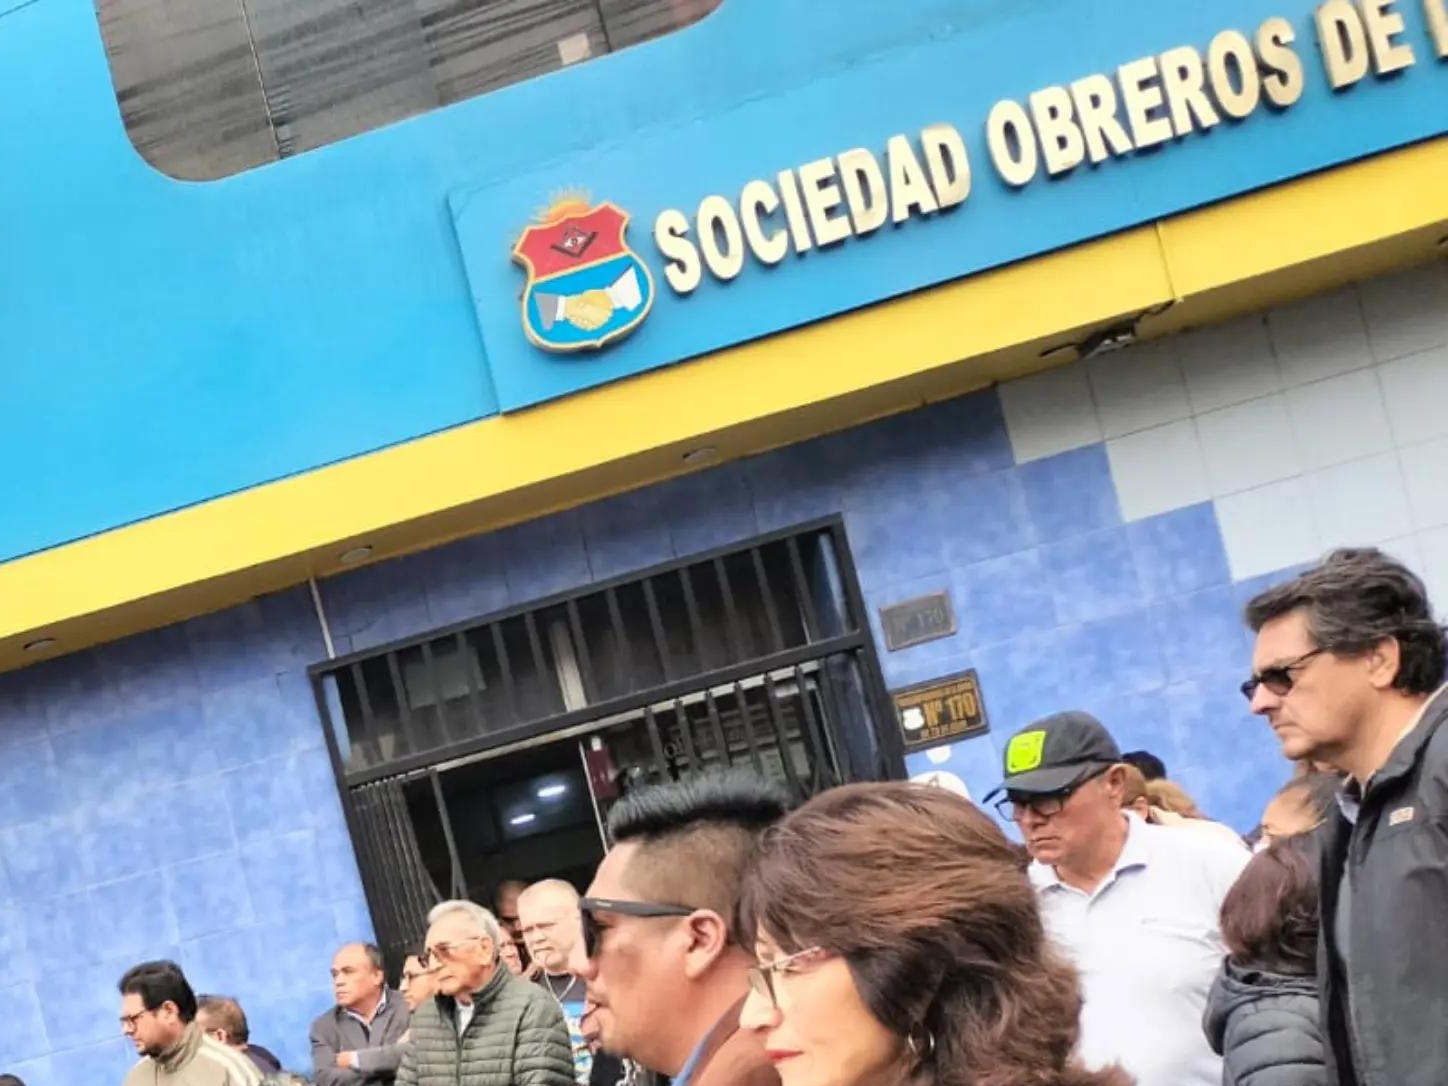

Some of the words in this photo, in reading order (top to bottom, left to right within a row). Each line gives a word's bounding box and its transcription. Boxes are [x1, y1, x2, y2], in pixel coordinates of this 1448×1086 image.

[654, 121, 972, 293] SOCIEDAD
[986, 16, 1304, 186] OBREROS
[1316, 0, 1417, 89] DE
[944, 691, 977, 721] 170
